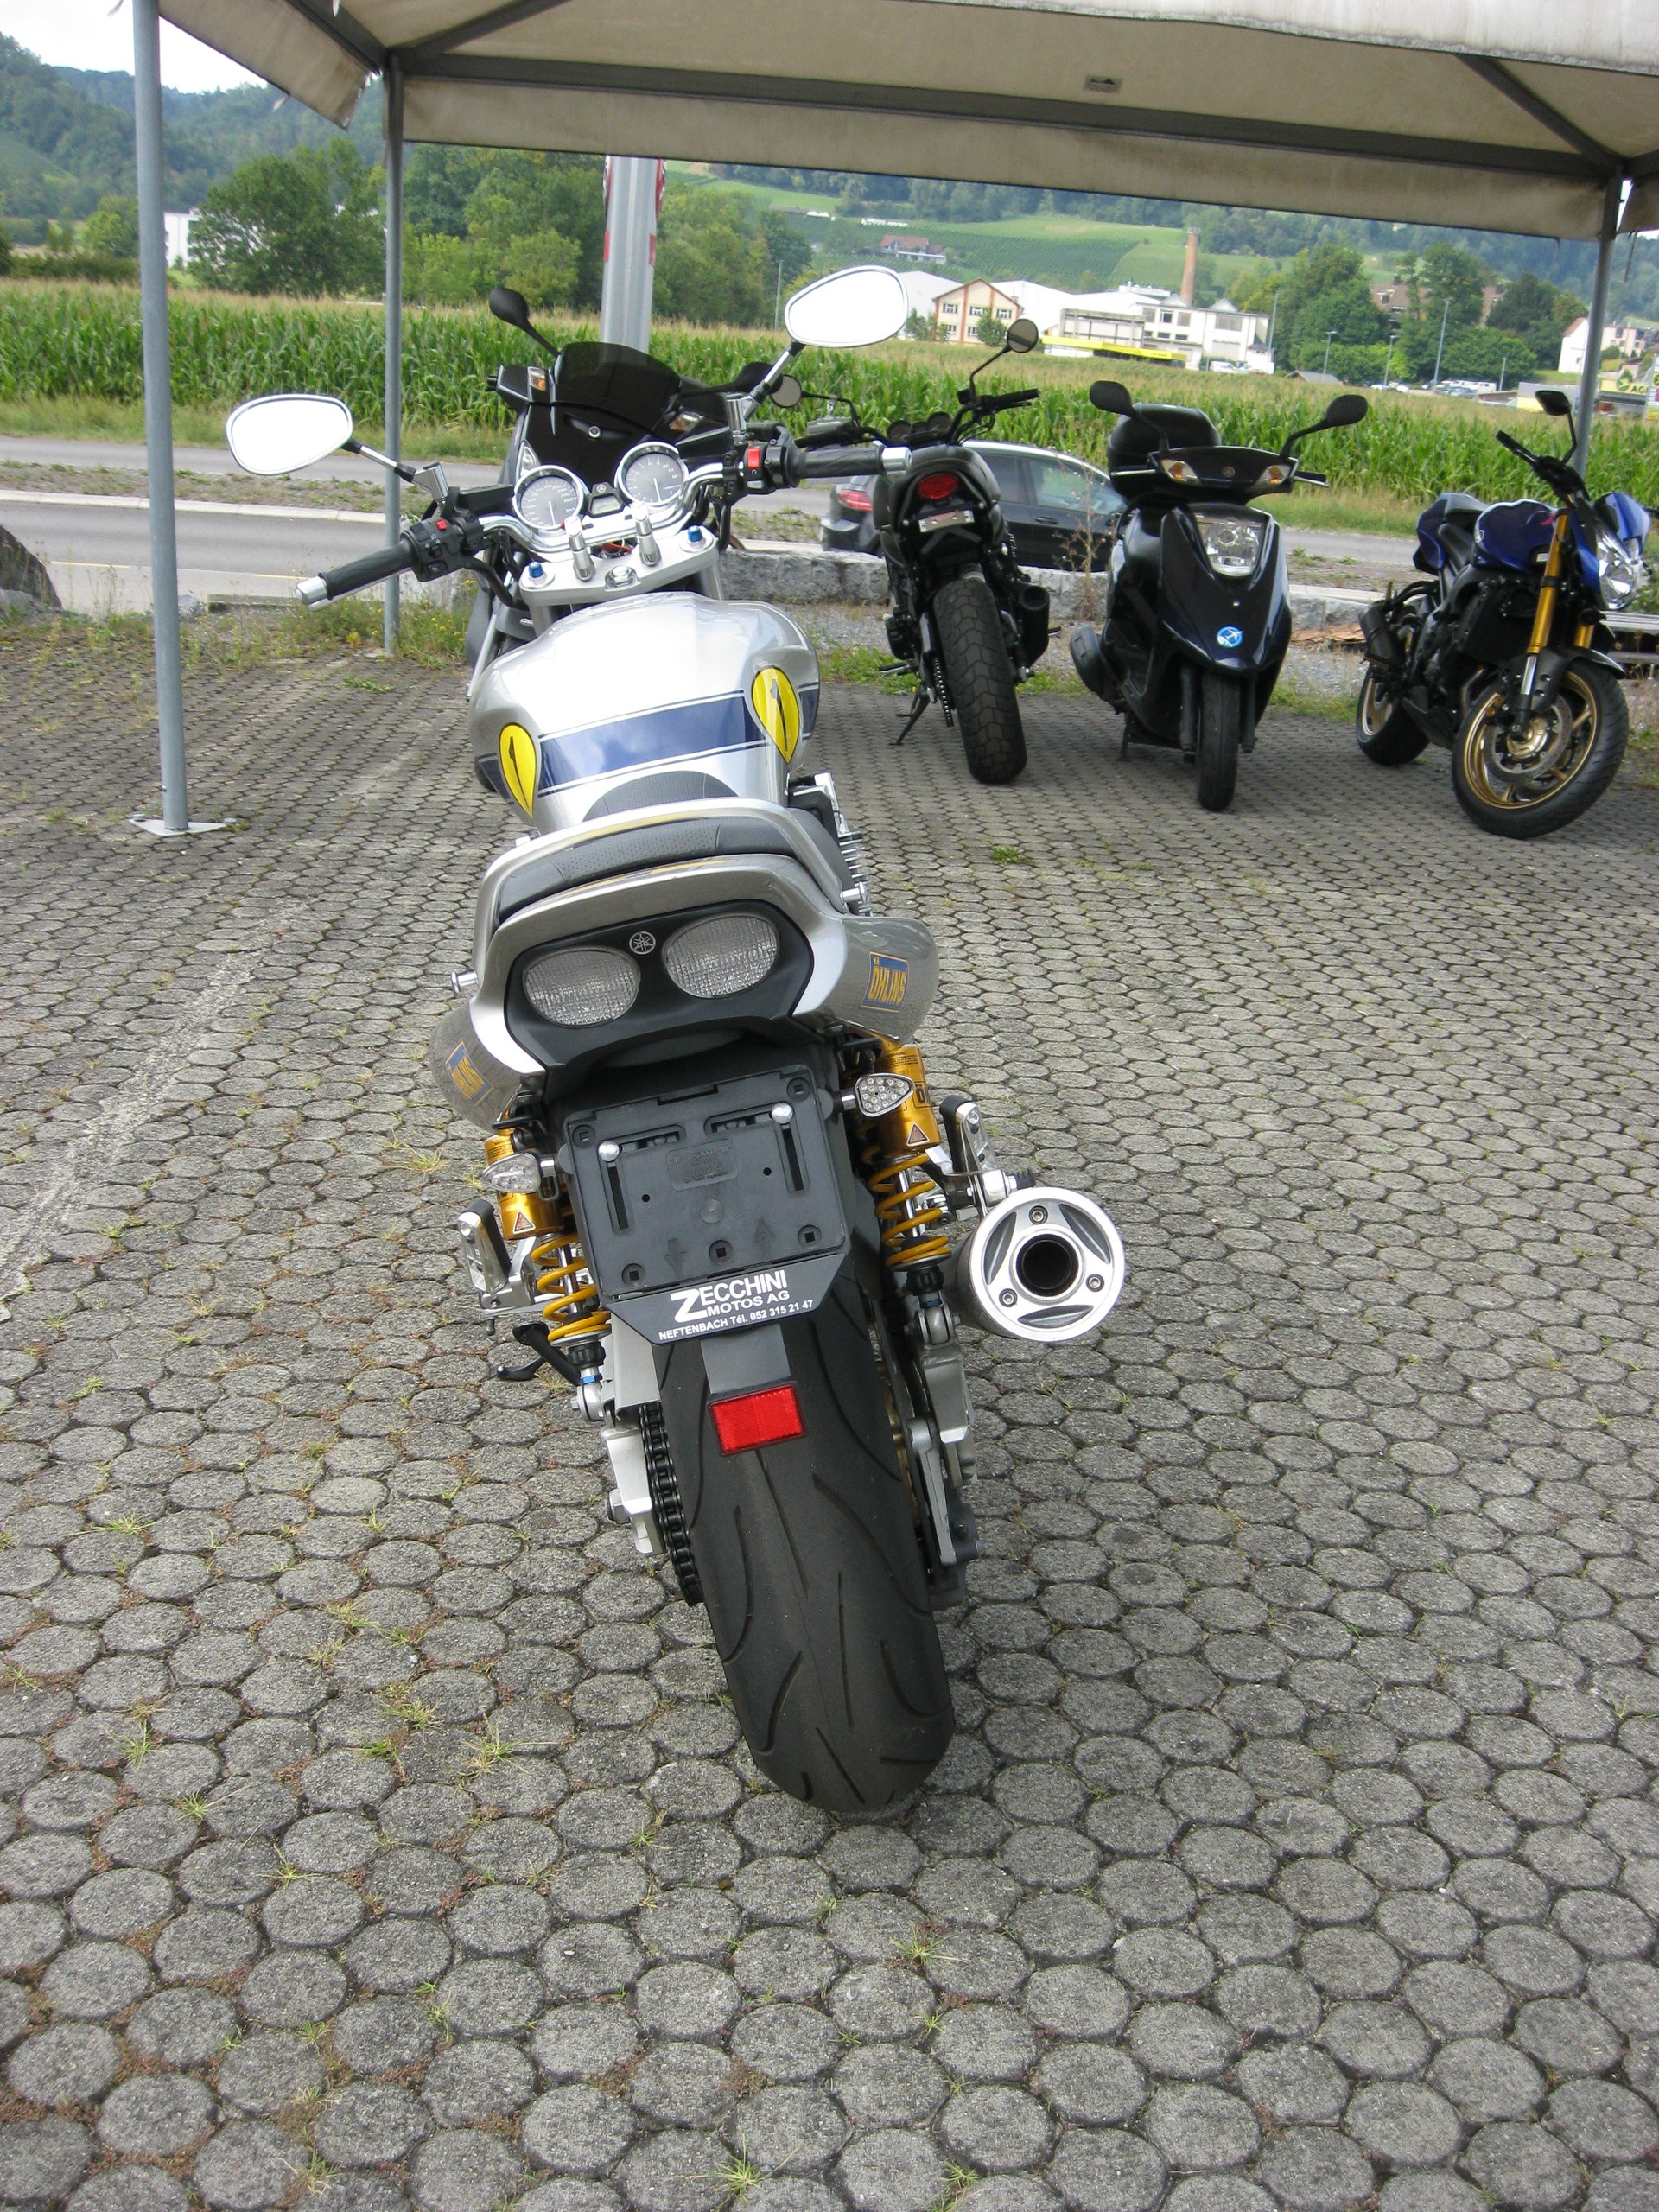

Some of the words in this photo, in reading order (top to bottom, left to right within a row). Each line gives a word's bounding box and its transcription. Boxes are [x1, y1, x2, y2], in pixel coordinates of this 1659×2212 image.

[670, 1270, 788, 1323] ZECCHINI
[707, 1297, 764, 1317] MOTOS
[766, 1290, 790, 1306] AG
[659, 1319, 728, 1340] NEFTENBACH
[729, 1313, 748, 1325] Tél.
[750, 1306, 768, 1320] 052
[770, 1304, 786, 1317] 315
[789, 1303, 800, 1313] 21
[802, 1299, 814, 1310] 47
